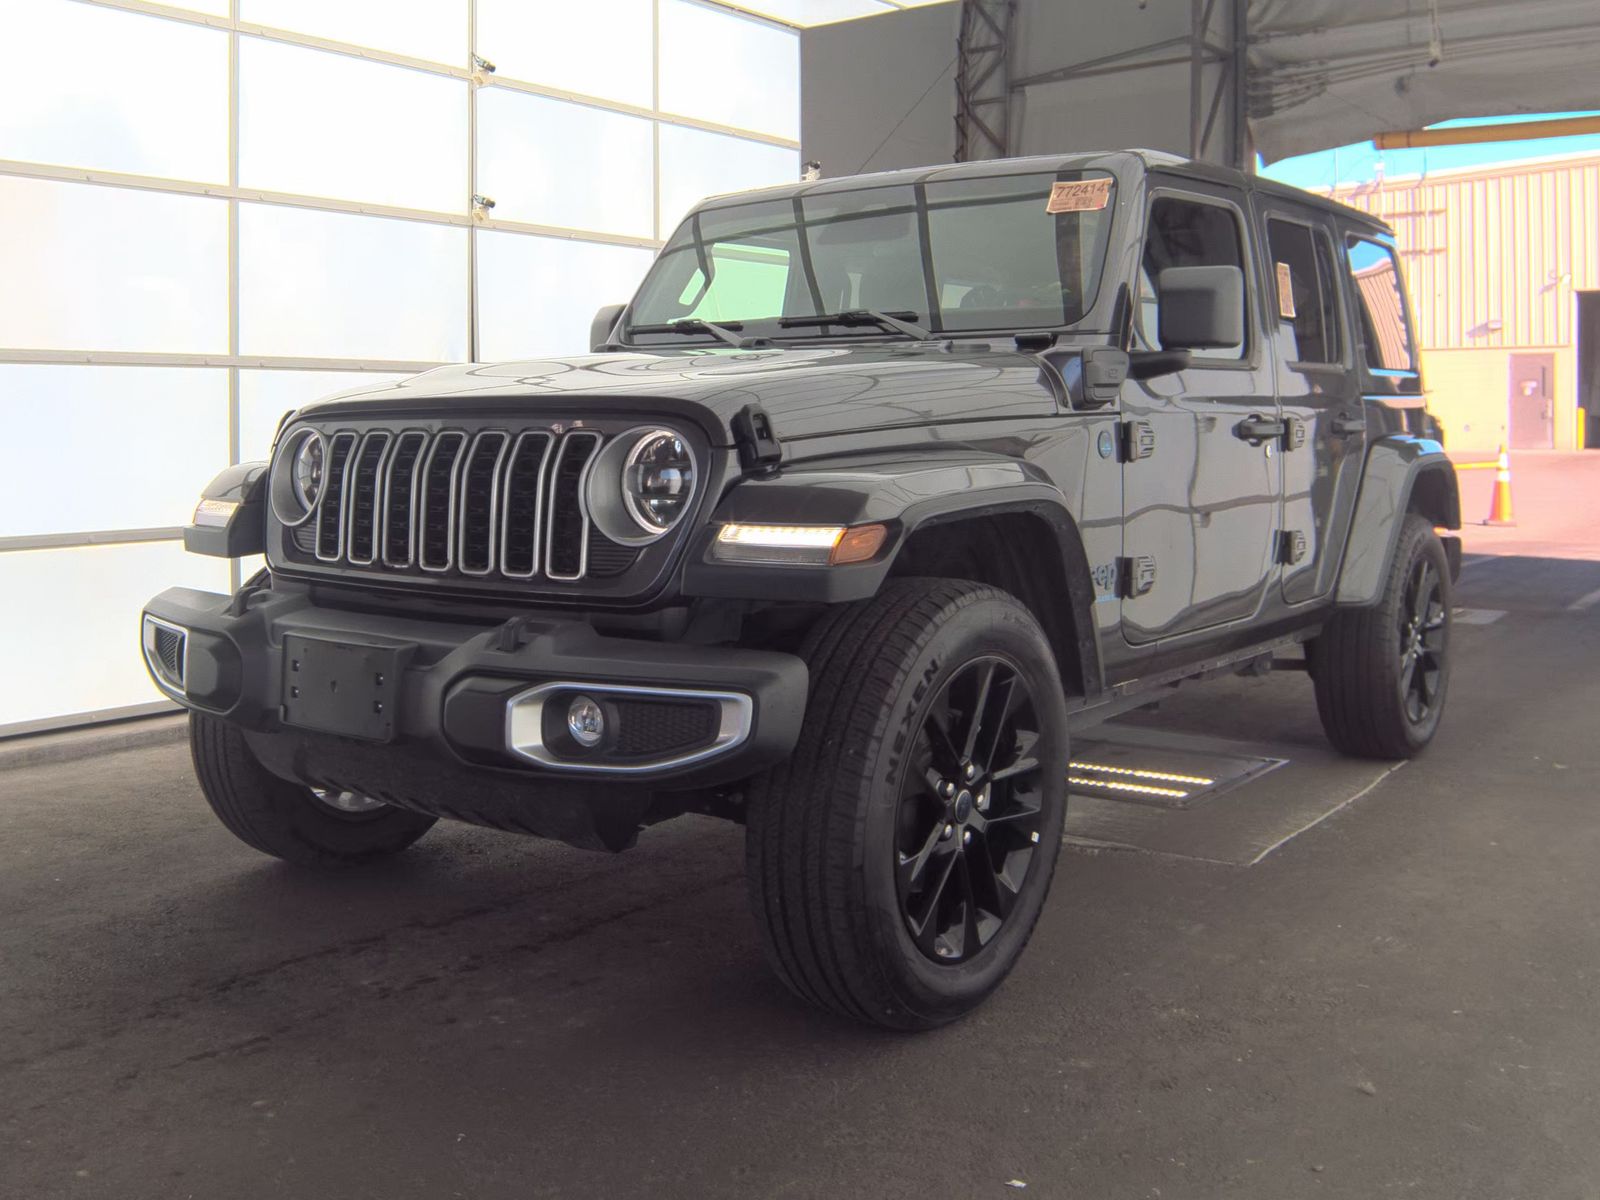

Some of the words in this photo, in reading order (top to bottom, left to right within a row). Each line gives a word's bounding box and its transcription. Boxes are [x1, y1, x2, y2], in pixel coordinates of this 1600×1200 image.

[1056, 183, 1105, 198] 772414
[1090, 563, 1115, 591] eep
[885, 658, 939, 786] NEXEN
